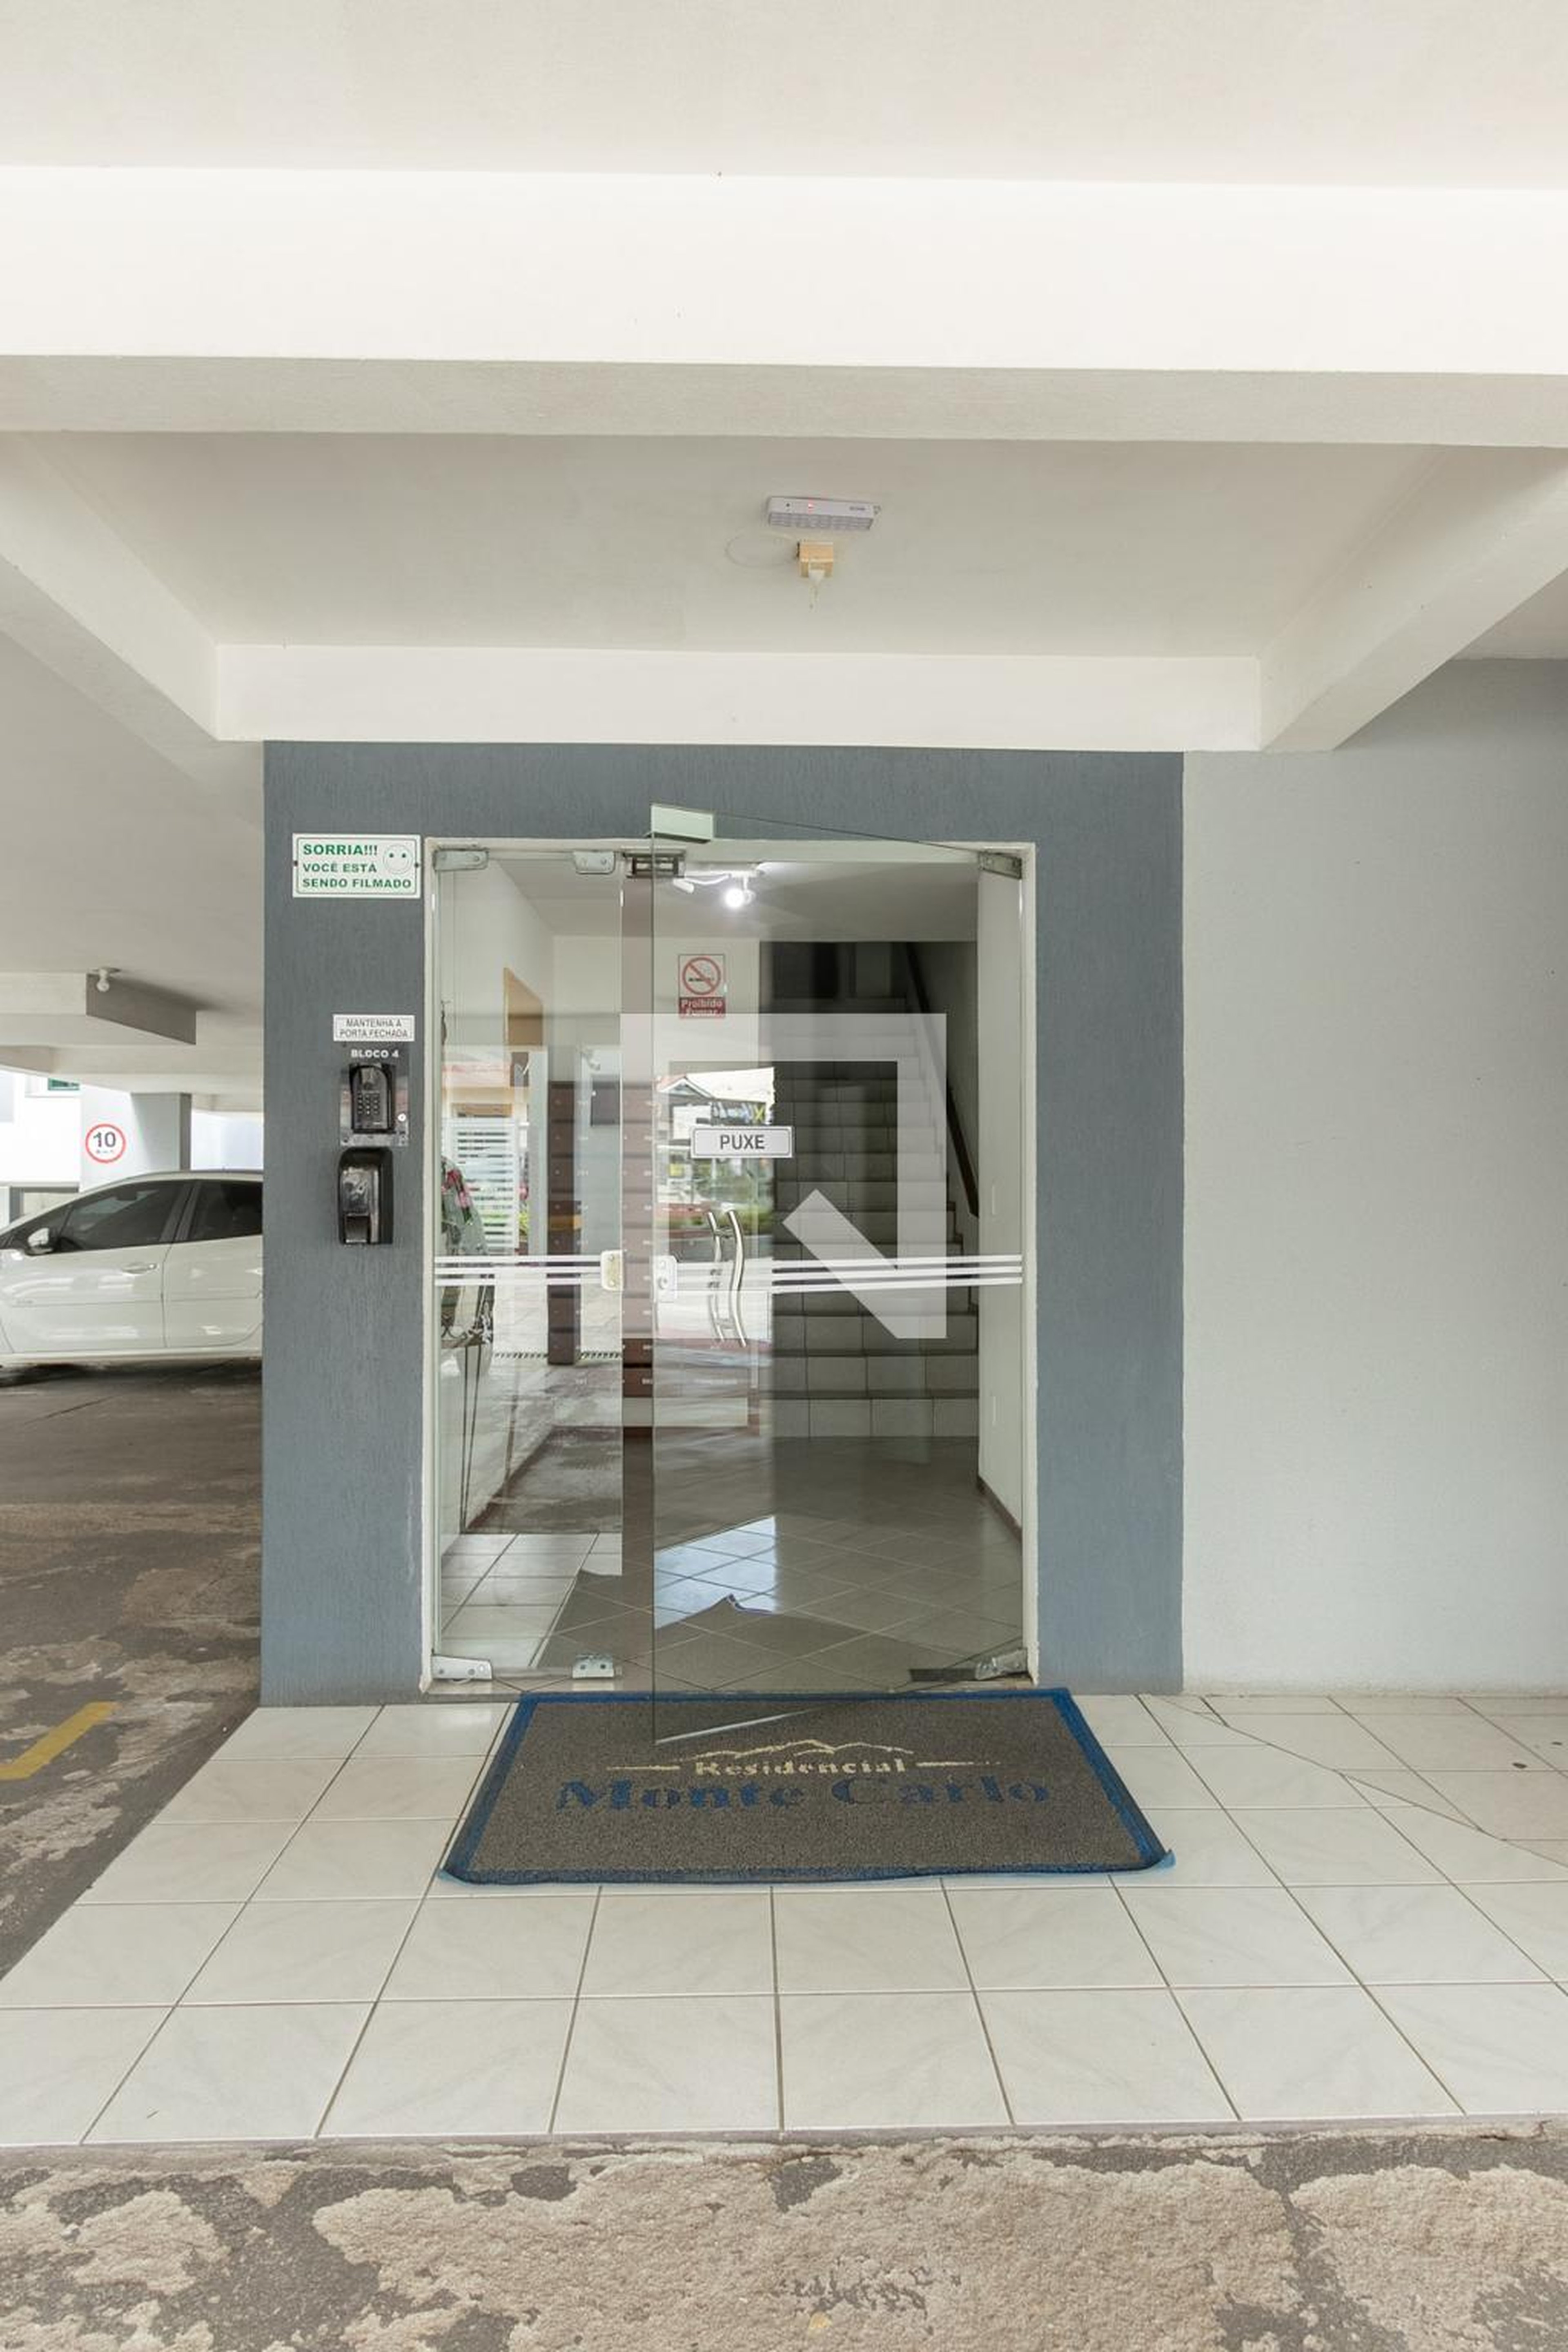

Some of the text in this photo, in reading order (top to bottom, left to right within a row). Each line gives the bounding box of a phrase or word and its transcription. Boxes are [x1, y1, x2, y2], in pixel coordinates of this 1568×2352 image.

[303, 844, 378, 855] SORRIA!!!
[303, 878, 412, 888] SENDO FILMADO
[340, 1029, 367, 1038] PORTA
[351, 1049, 389, 1058] BLOCO
[93, 1131, 116, 1147] 10
[720, 1135, 765, 1149] PUXE
[695, 1758, 906, 1776] Residencial
[556, 1775, 1050, 1810] Monte Carlo
